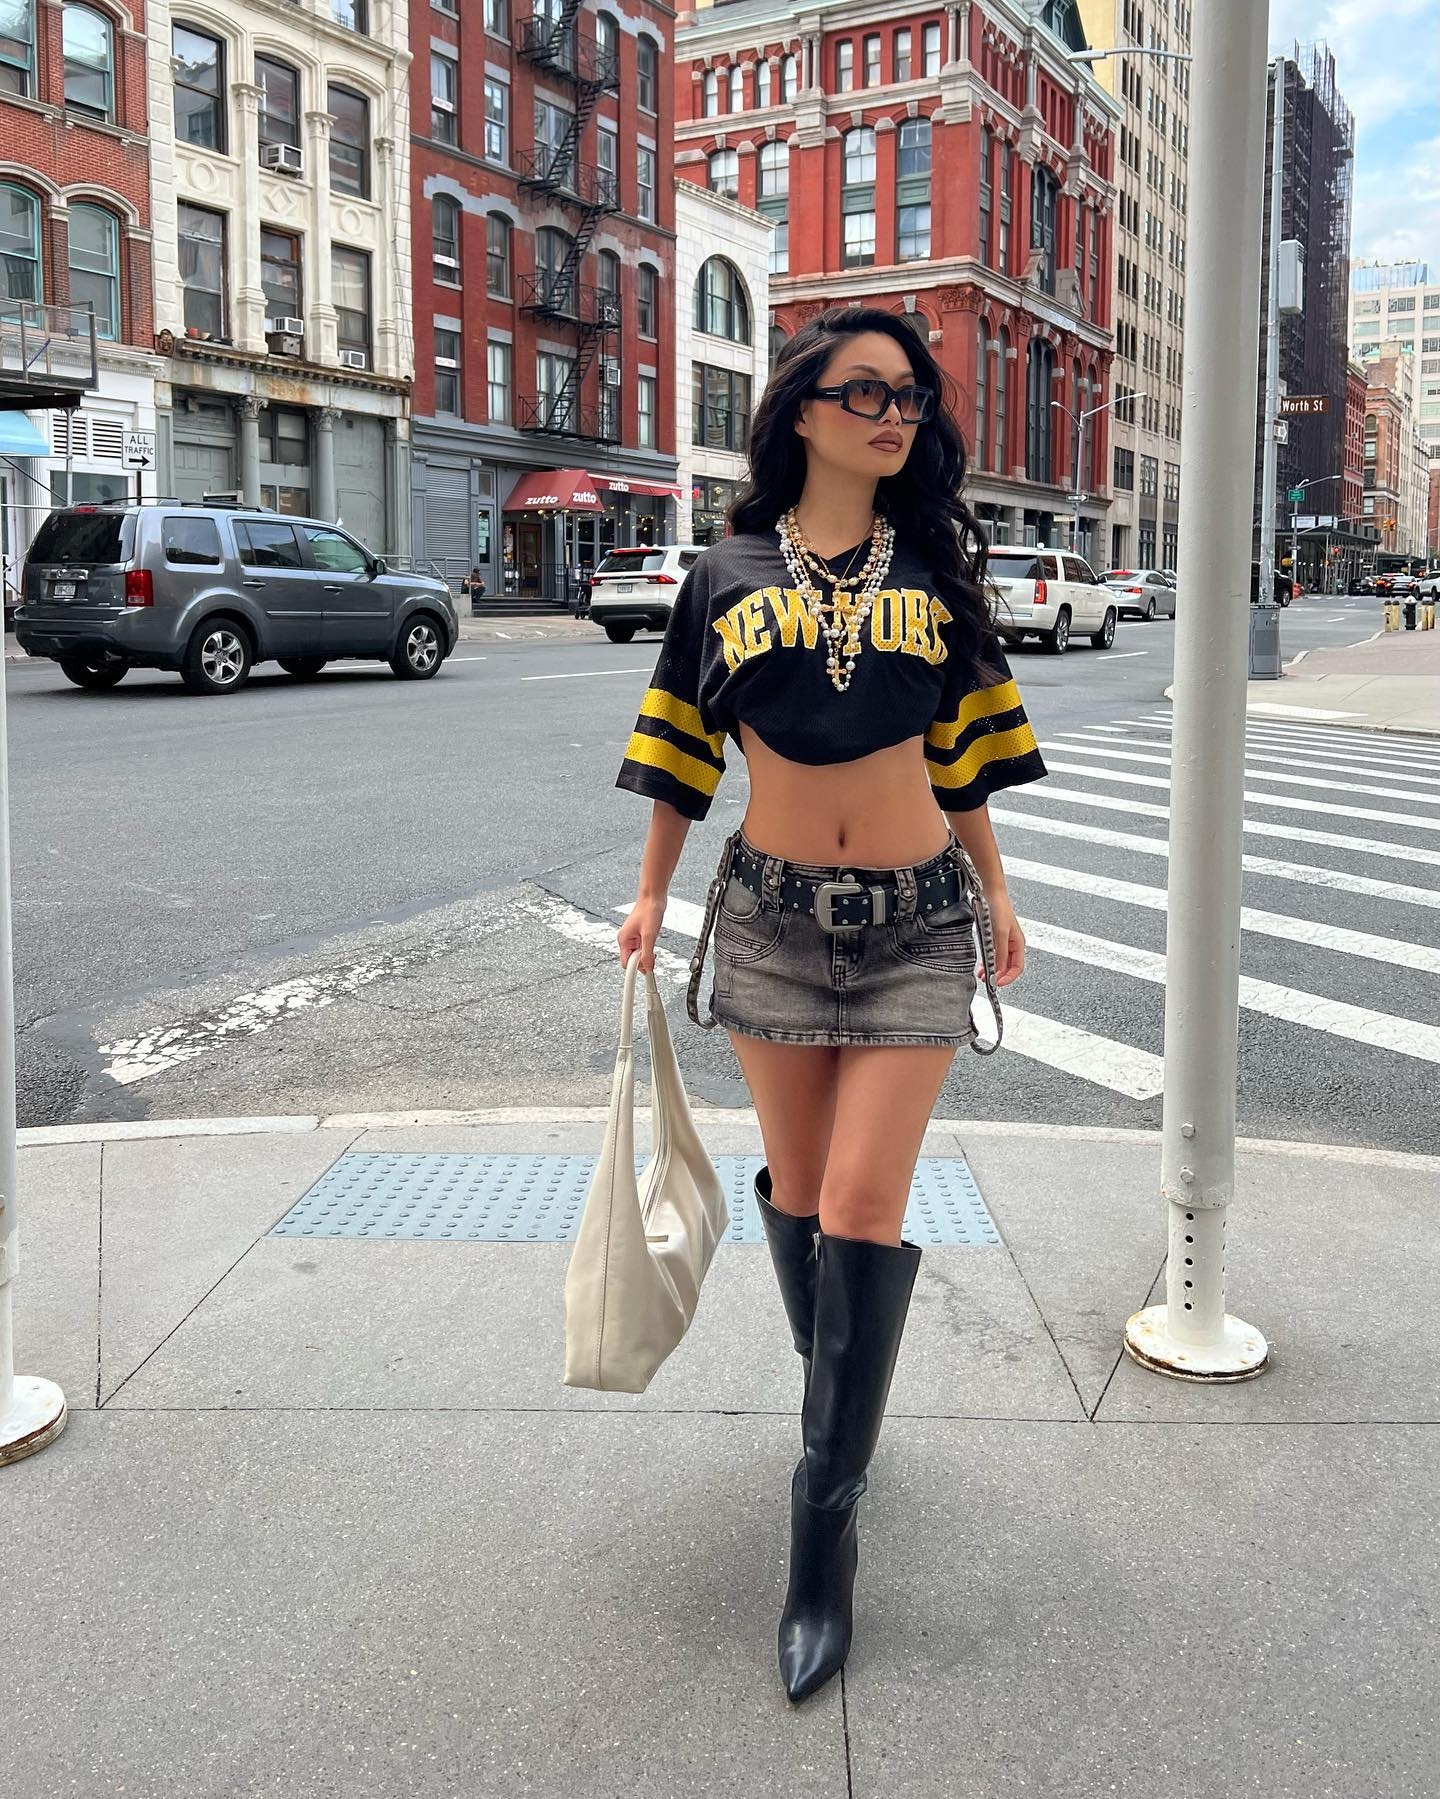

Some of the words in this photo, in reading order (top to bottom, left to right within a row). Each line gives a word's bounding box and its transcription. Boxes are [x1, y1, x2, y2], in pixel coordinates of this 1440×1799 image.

[1282, 400, 1309, 412] Worth
[1313, 400, 1323, 411] St
[130, 435, 149, 445] ALL
[124, 446, 154, 455] TRAFFIC
[608, 481, 629, 492] zutto
[525, 495, 558, 505] zutto
[572, 491, 597, 504] zutto
[712, 586, 823, 675] NEW
